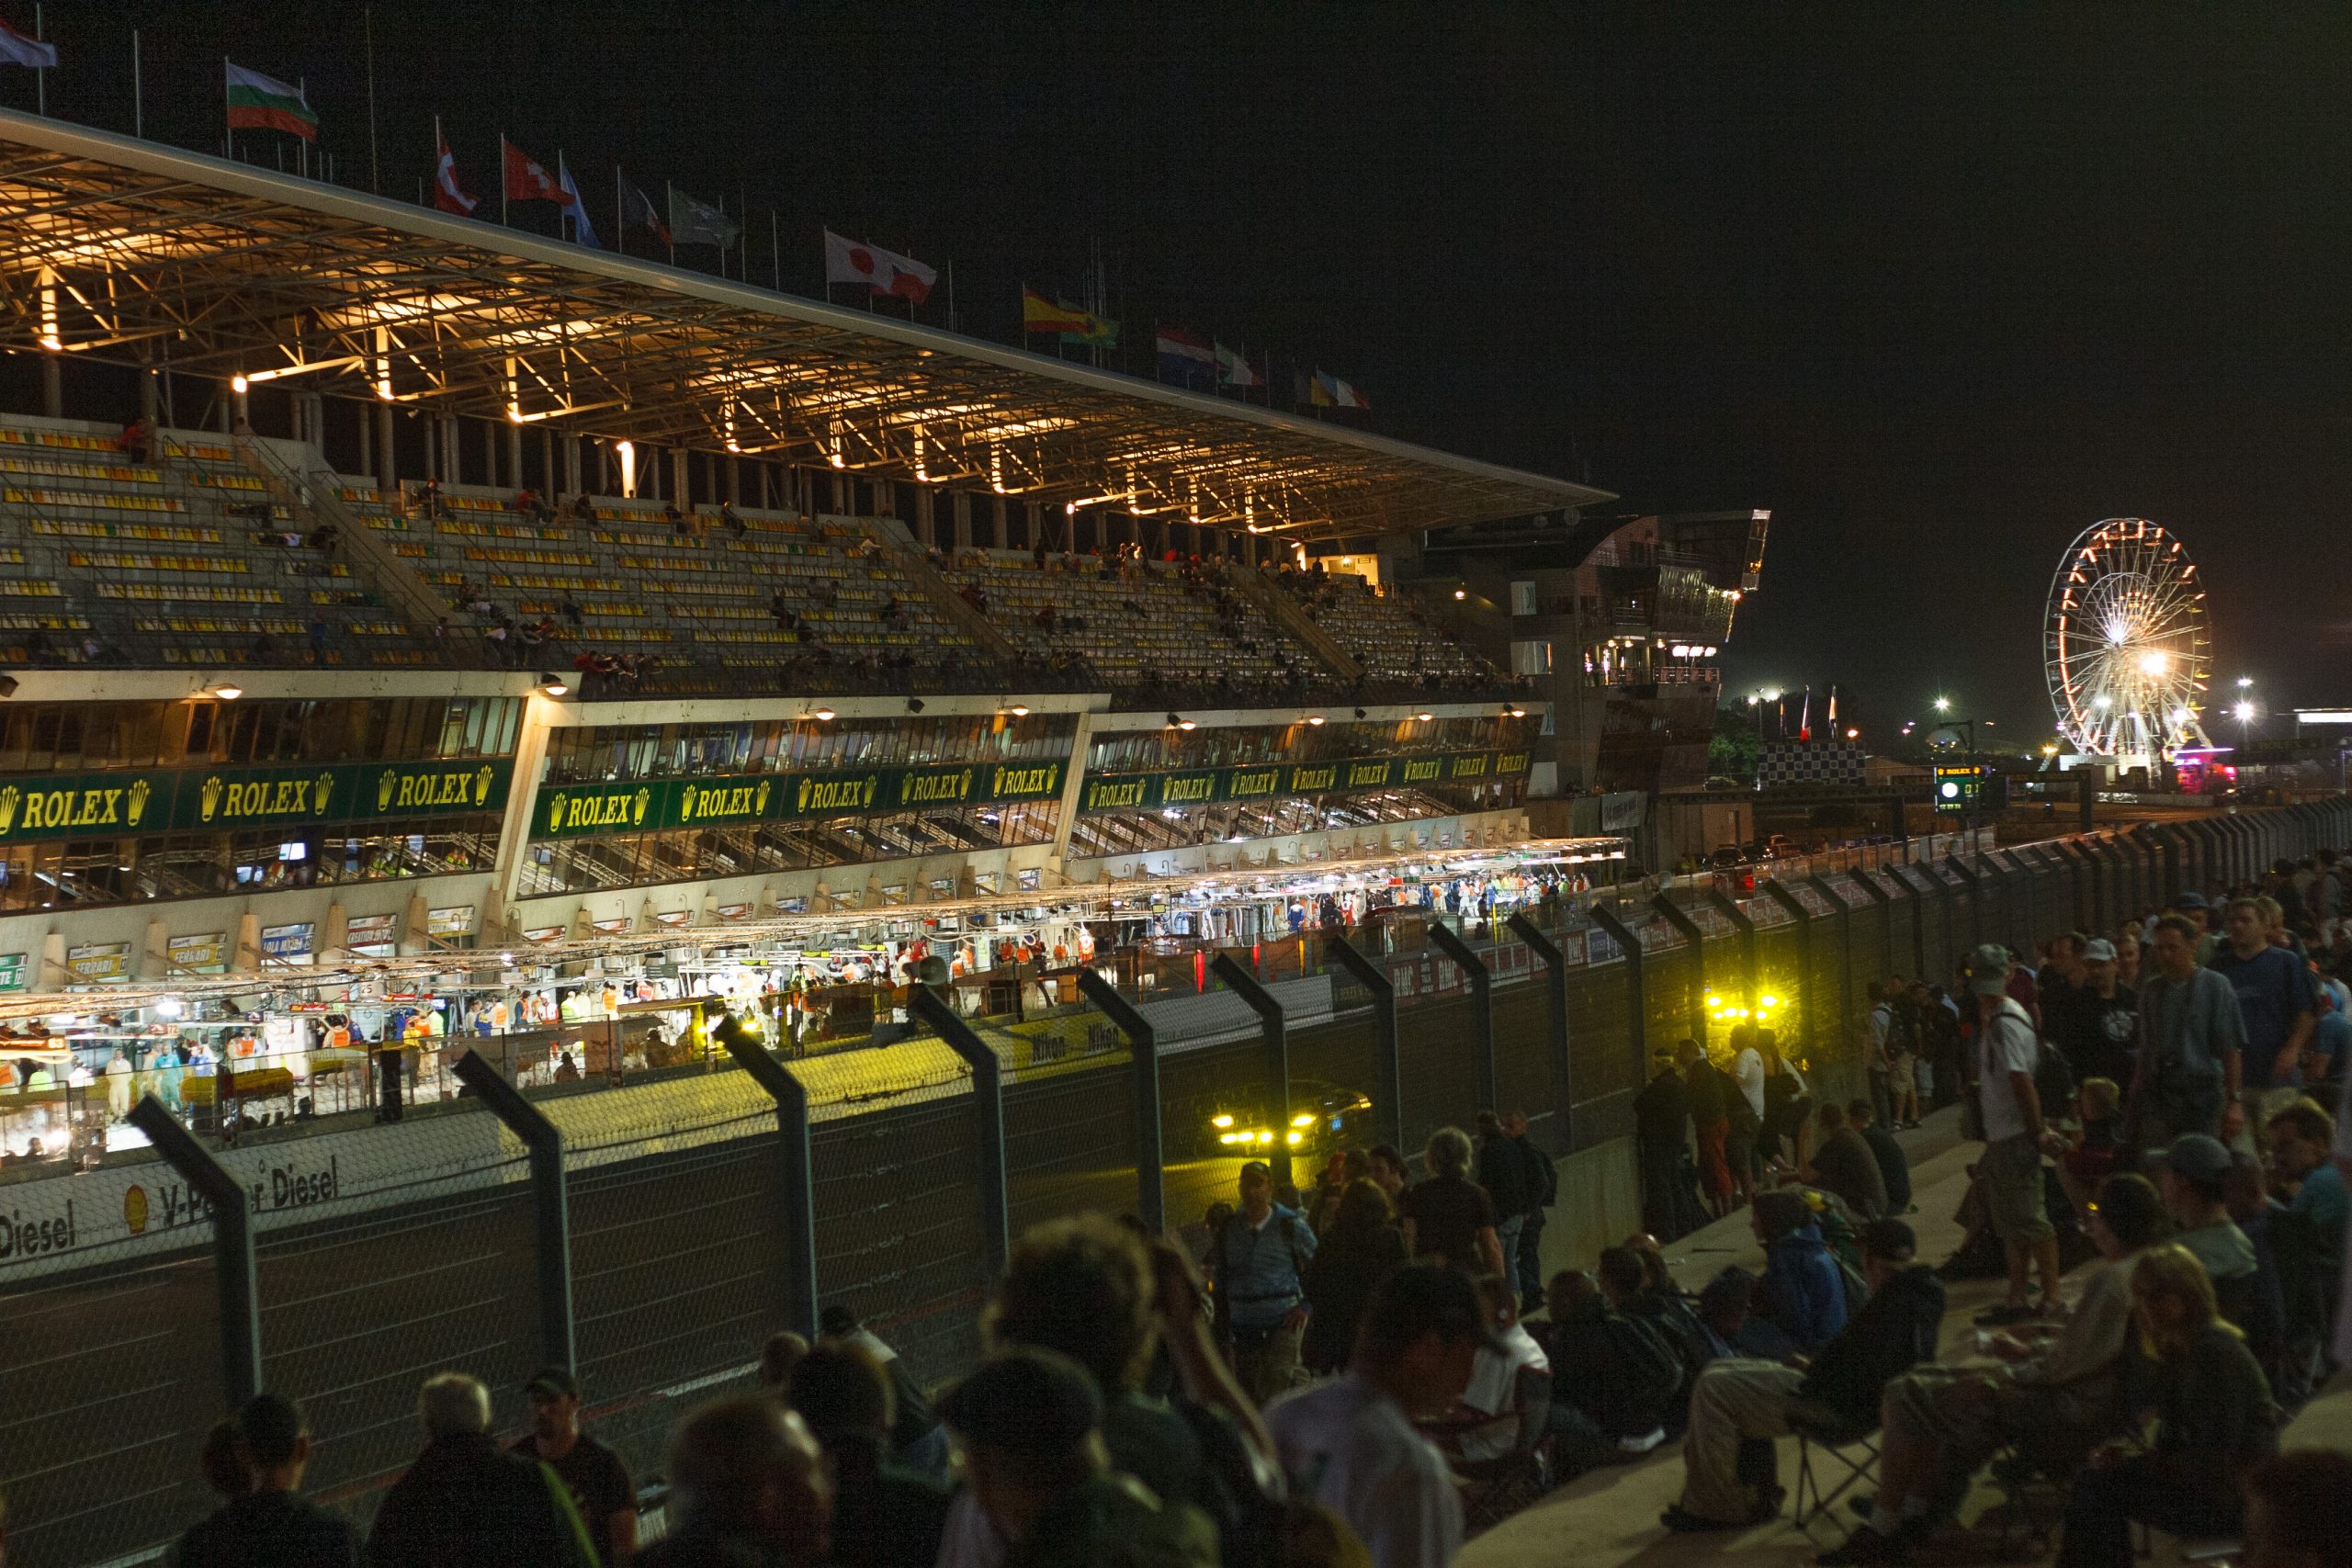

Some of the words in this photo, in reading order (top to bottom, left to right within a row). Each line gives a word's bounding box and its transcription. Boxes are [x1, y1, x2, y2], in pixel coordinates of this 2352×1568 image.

[1356, 763, 1382, 785] ROLEX
[1412, 760, 1435, 781] ROLEX
[1458, 756, 1481, 777] ROLEX
[1504, 753, 1524, 773] ROLEX
[397, 773, 473, 807] ROLEX
[912, 773, 958, 800] ROLEX
[1005, 768, 1046, 794] ROLEX
[1171, 778, 1204, 801] ROLEX
[1240, 773, 1270, 795] ROLEX
[1300, 768, 1329, 790] ROLEX
[224, 780, 311, 818] ROLEX
[695, 786, 753, 817] ROLEX
[811, 780, 863, 809] ROLEX
[1098, 784, 1136, 809] ROLEX
[22, 789, 123, 829] ROLEX
[566, 794, 633, 827] ROLEX
[361, 984, 373, 994] 25
[1033, 1031, 1066, 1063] Nikon
[1089, 1022, 1119, 1053] Nikon
[272, 1154, 340, 1208] Diesel
[0, 1198, 75, 1258] Diesel
